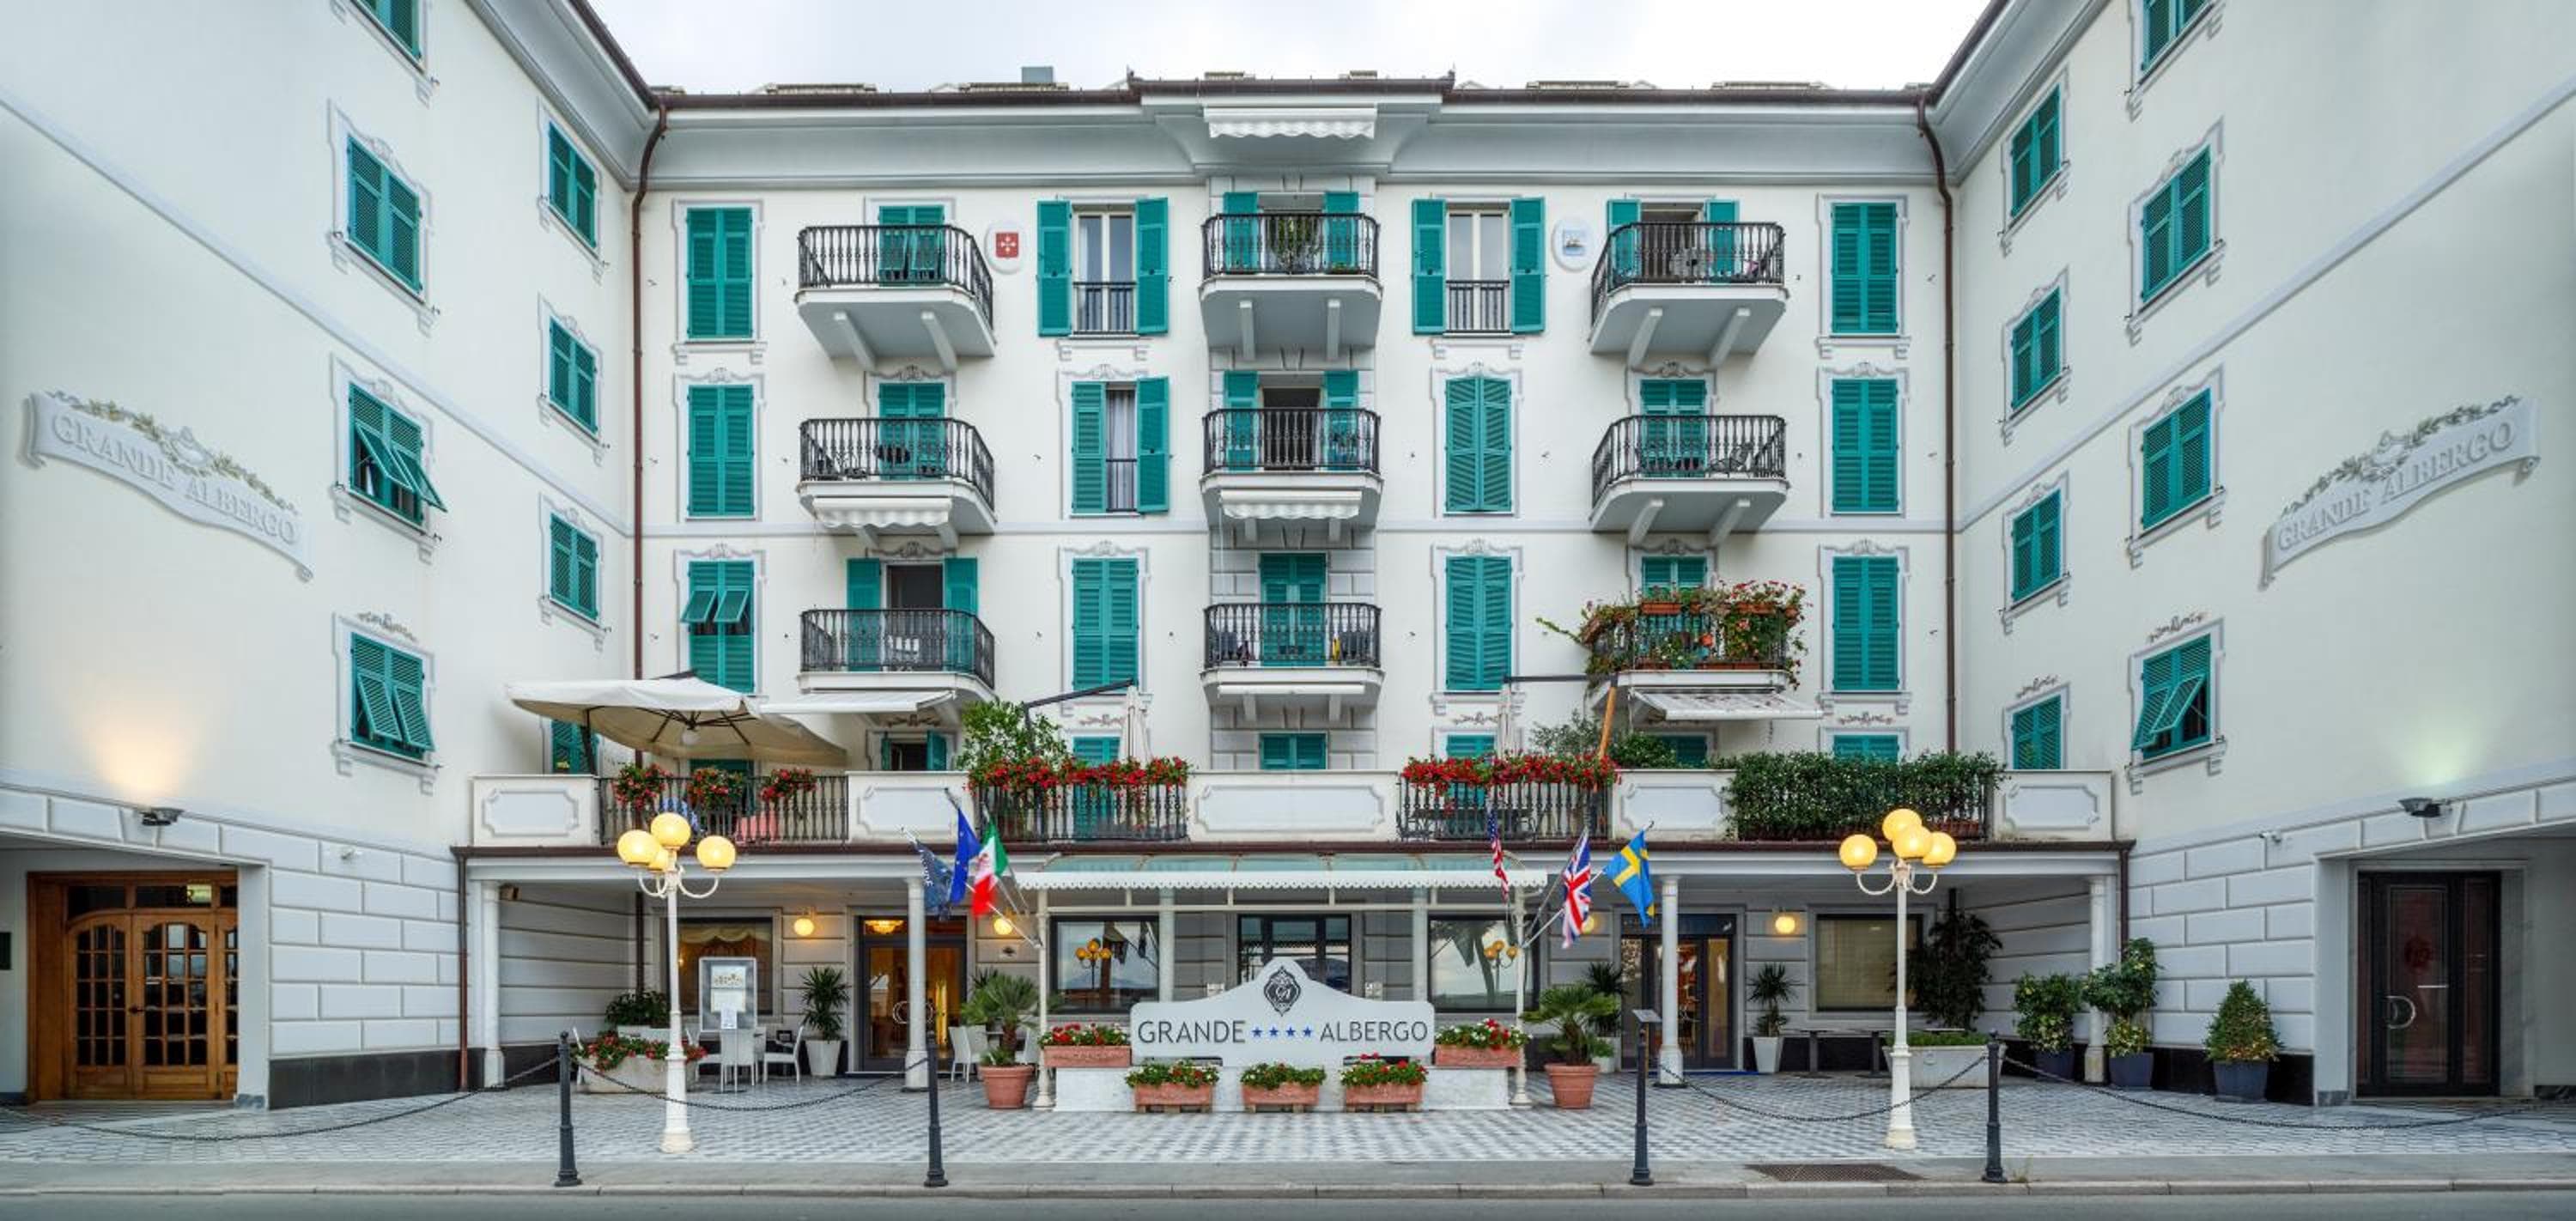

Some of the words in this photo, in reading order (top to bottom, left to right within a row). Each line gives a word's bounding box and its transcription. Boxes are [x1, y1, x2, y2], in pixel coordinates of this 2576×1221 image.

[52, 413, 175, 490] GRANDE
[185, 476, 298, 545] ALBERGO
[2277, 488, 2372, 550] GRANDE
[2382, 422, 2514, 502] ALBERGO
[1138, 1020, 1245, 1044] GRANDE
[1320, 1020, 1428, 1042] ALBERGO
